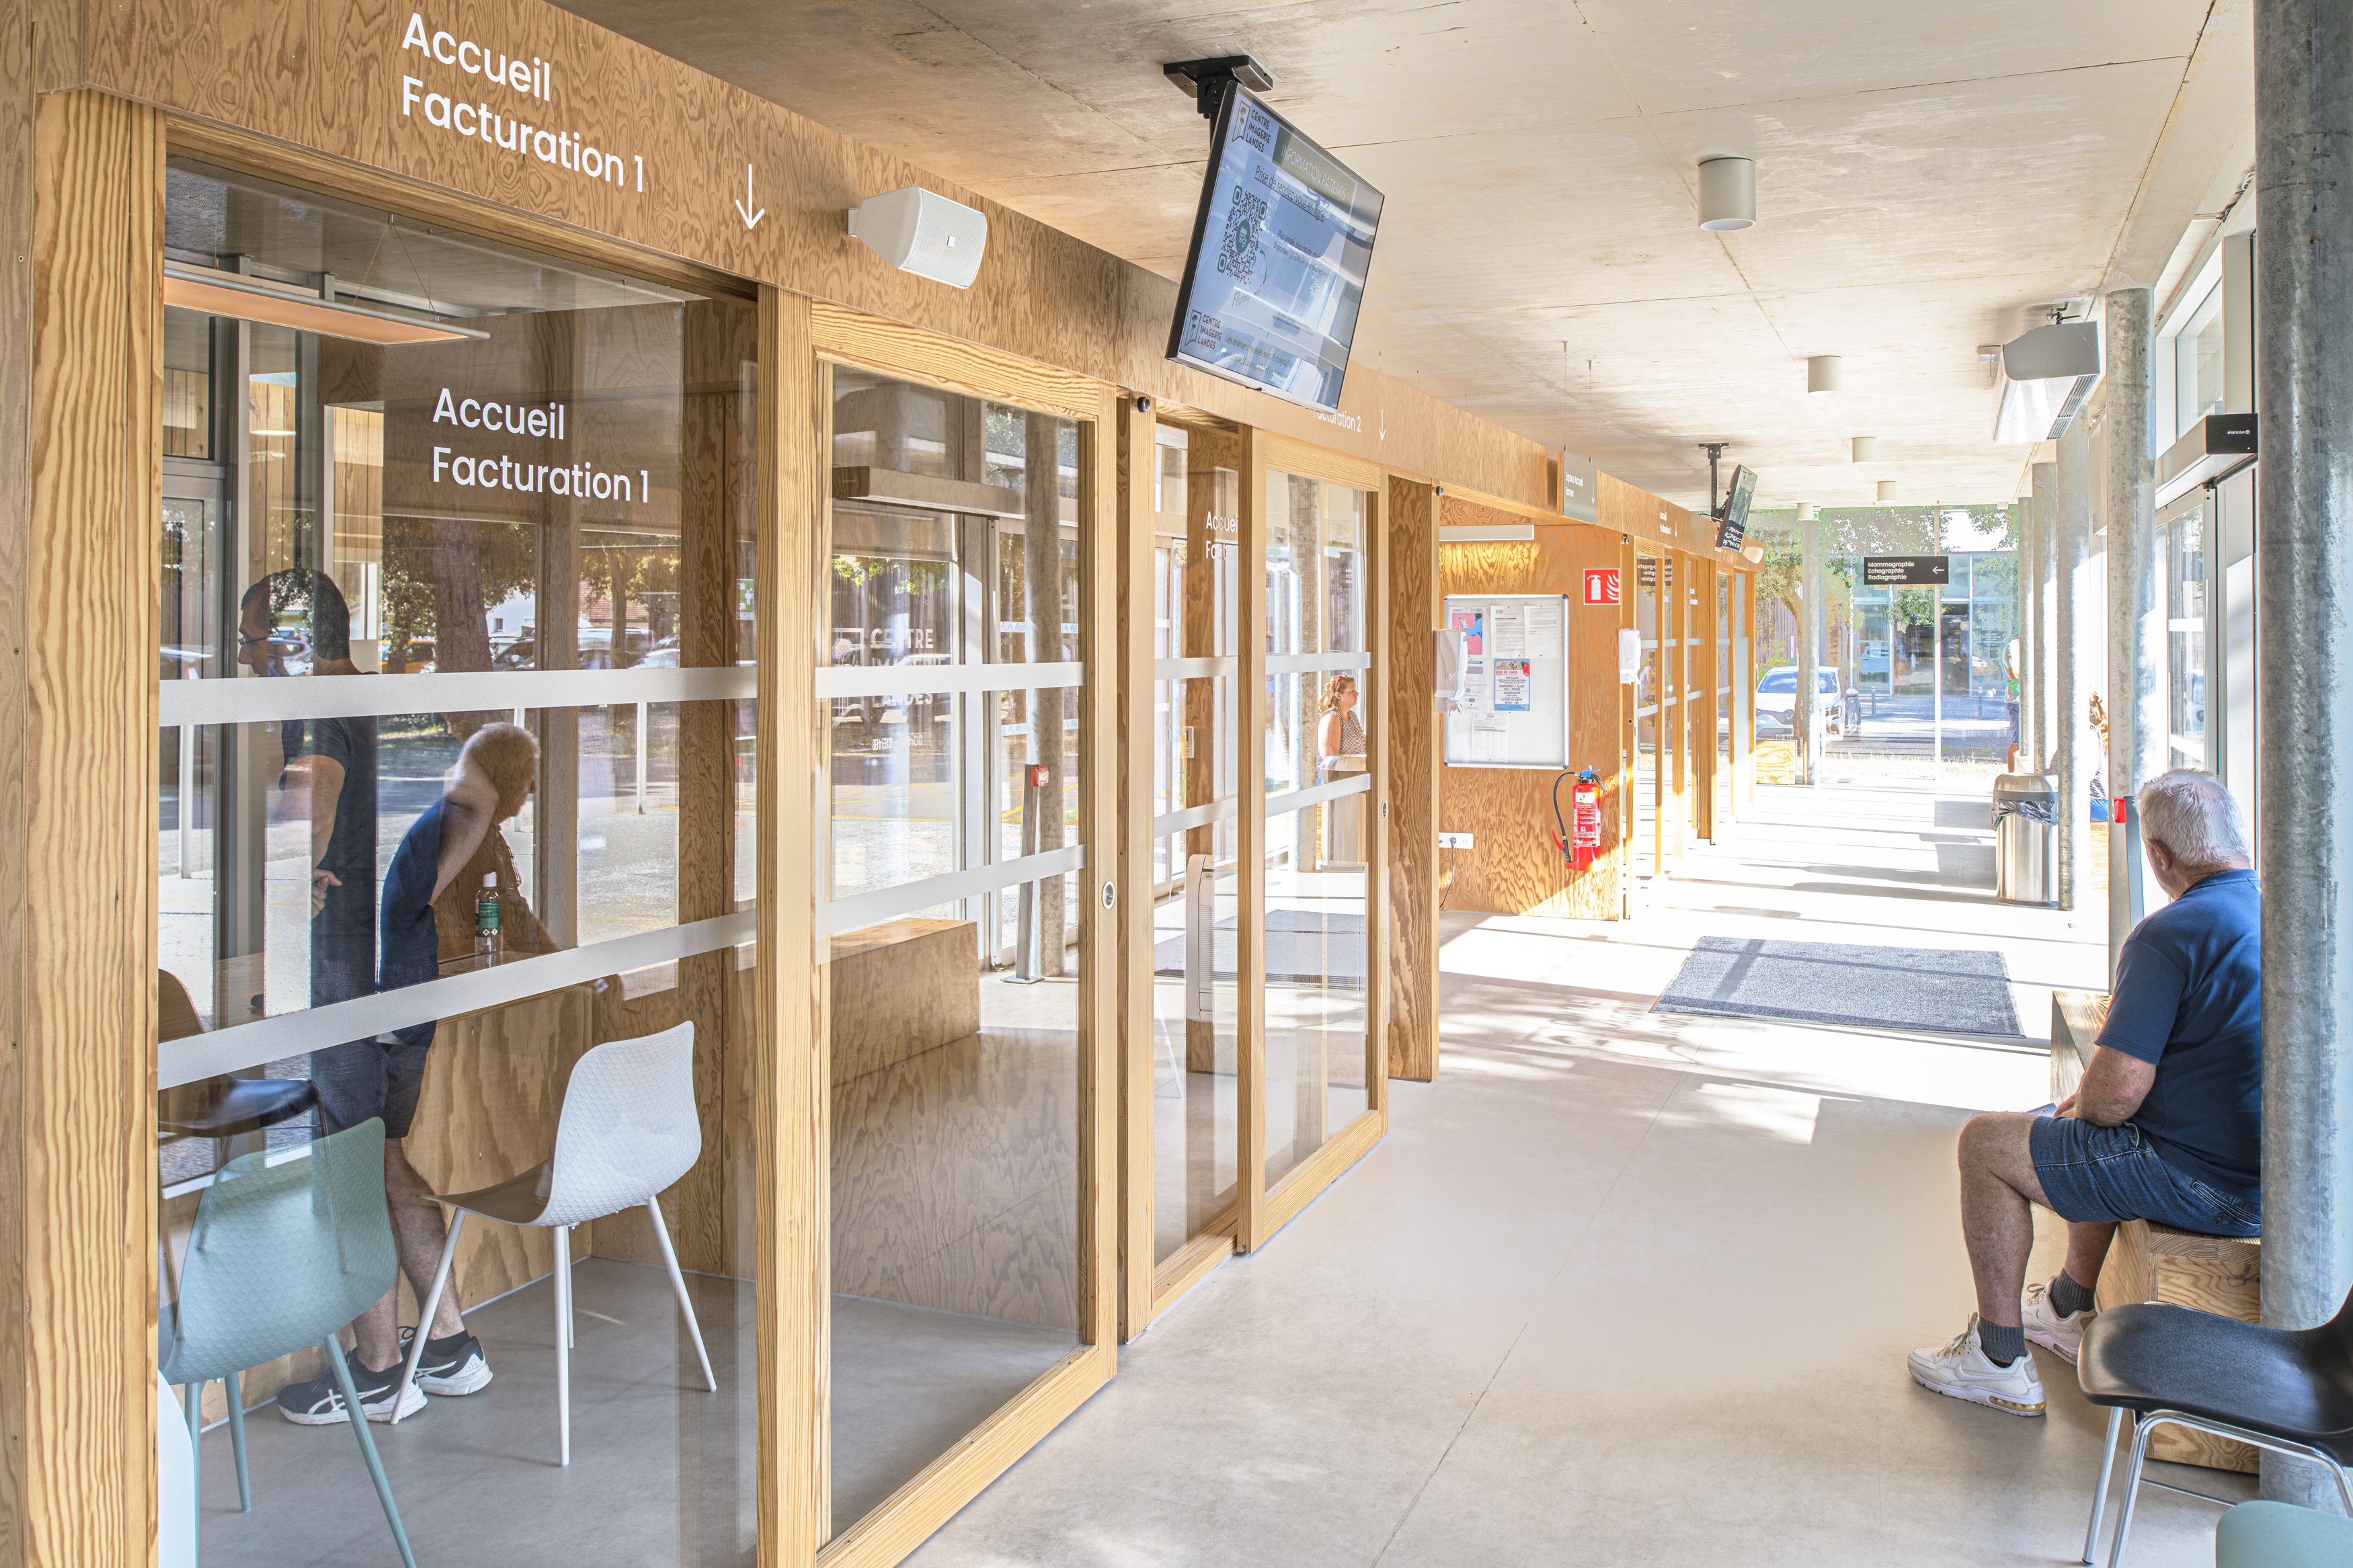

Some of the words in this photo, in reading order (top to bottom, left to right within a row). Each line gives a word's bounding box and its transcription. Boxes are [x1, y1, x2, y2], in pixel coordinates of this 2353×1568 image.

[402, 12, 551, 101] Accueil
[1251, 109, 1269, 129] CENTRE
[403, 75, 624, 186] Facturation
[635, 155, 643, 193] 1
[1246, 133, 1264, 152] LANDES
[1249, 121, 1270, 143] IMAGERIE
[1281, 144, 1322, 183] INFORMATION
[1322, 174, 1346, 200] PATIENTS
[1256, 165, 1269, 183] Prise
[1269, 174, 1276, 188] de
[1277, 179, 1307, 208] rendez-vous
[1307, 202, 1313, 213] en
[1313, 204, 1326, 224] ligne
[1273, 242, 1288, 256] Disponible
[1203, 315, 1220, 328] CENTRE
[1198, 337, 1215, 349] LANDES
[1200, 326, 1221, 340] IMAGERIE
[1233, 339, 1249, 350] examens
[433, 388, 564, 440] Accueil
[1357, 415, 1361, 433] 2
[434, 446, 630, 501] Facturation
[641, 470, 648, 503] 1
[1205, 511, 1238, 533] Accuei
